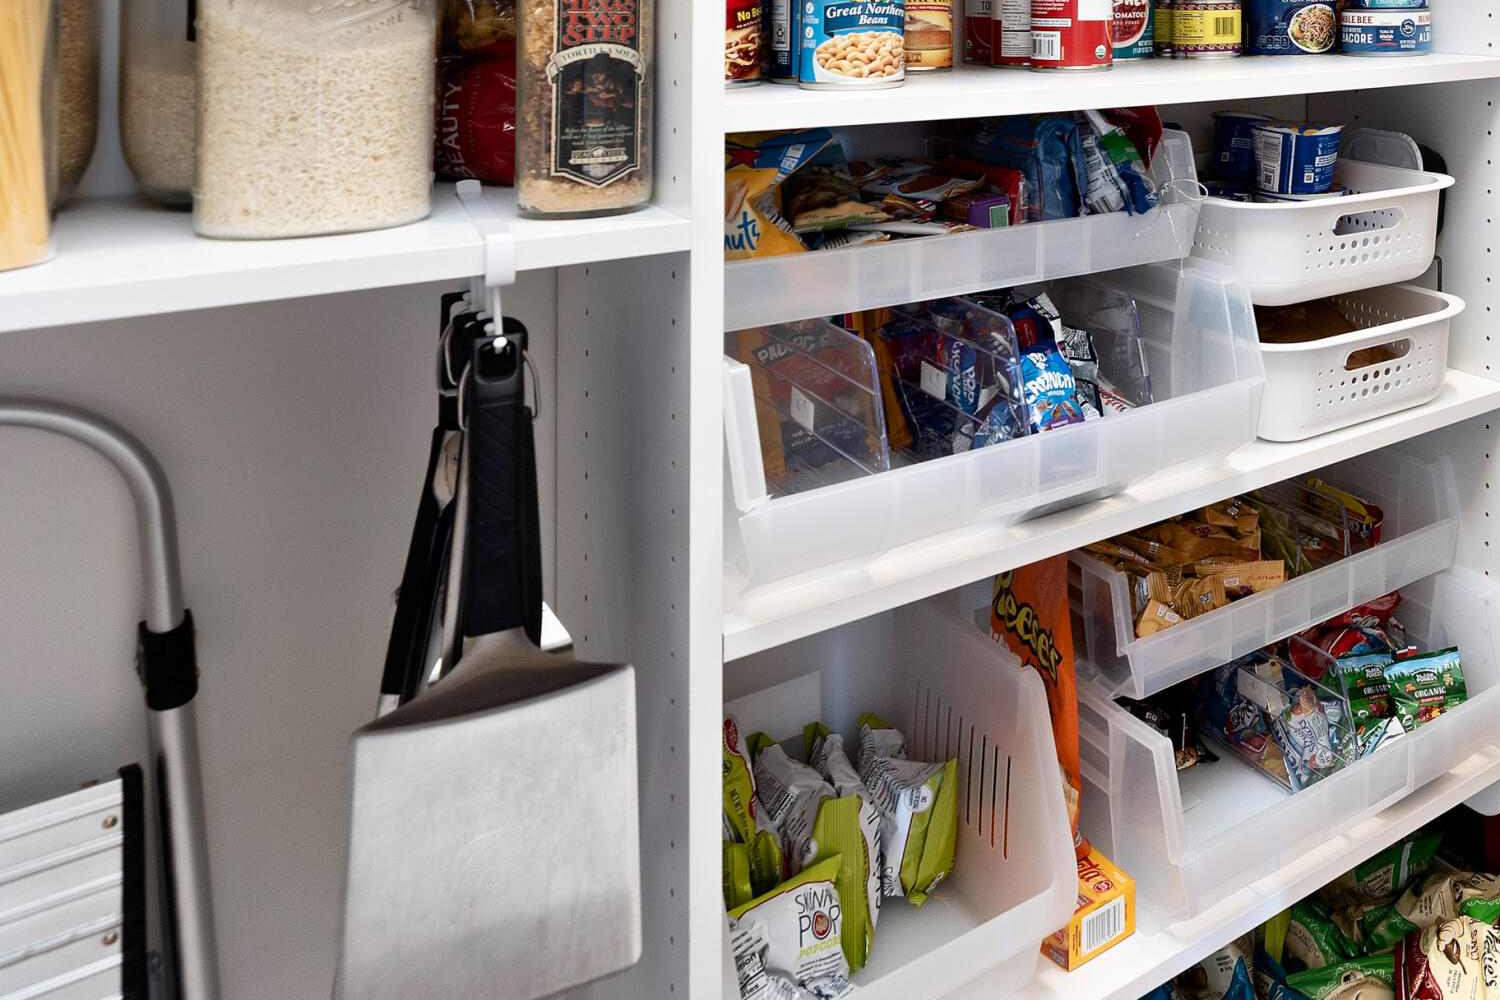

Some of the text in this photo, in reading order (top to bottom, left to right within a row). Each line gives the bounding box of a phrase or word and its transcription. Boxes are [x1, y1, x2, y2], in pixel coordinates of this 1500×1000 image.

[737, 10, 752, 22] No
[826, 3, 904, 20] Great Northern
[562, 12, 636, 27] TWO
[858, 15, 889, 25] Beans
[1357, 15, 1374, 24] BEE
[562, 26, 636, 45] STEP
[442, 82, 463, 177] BEAUTY
[1025, 371, 1076, 404] CRUNCH
[1363, 684, 1389, 696] ORGANIC
[1414, 686, 1447, 699] ORGANIC
